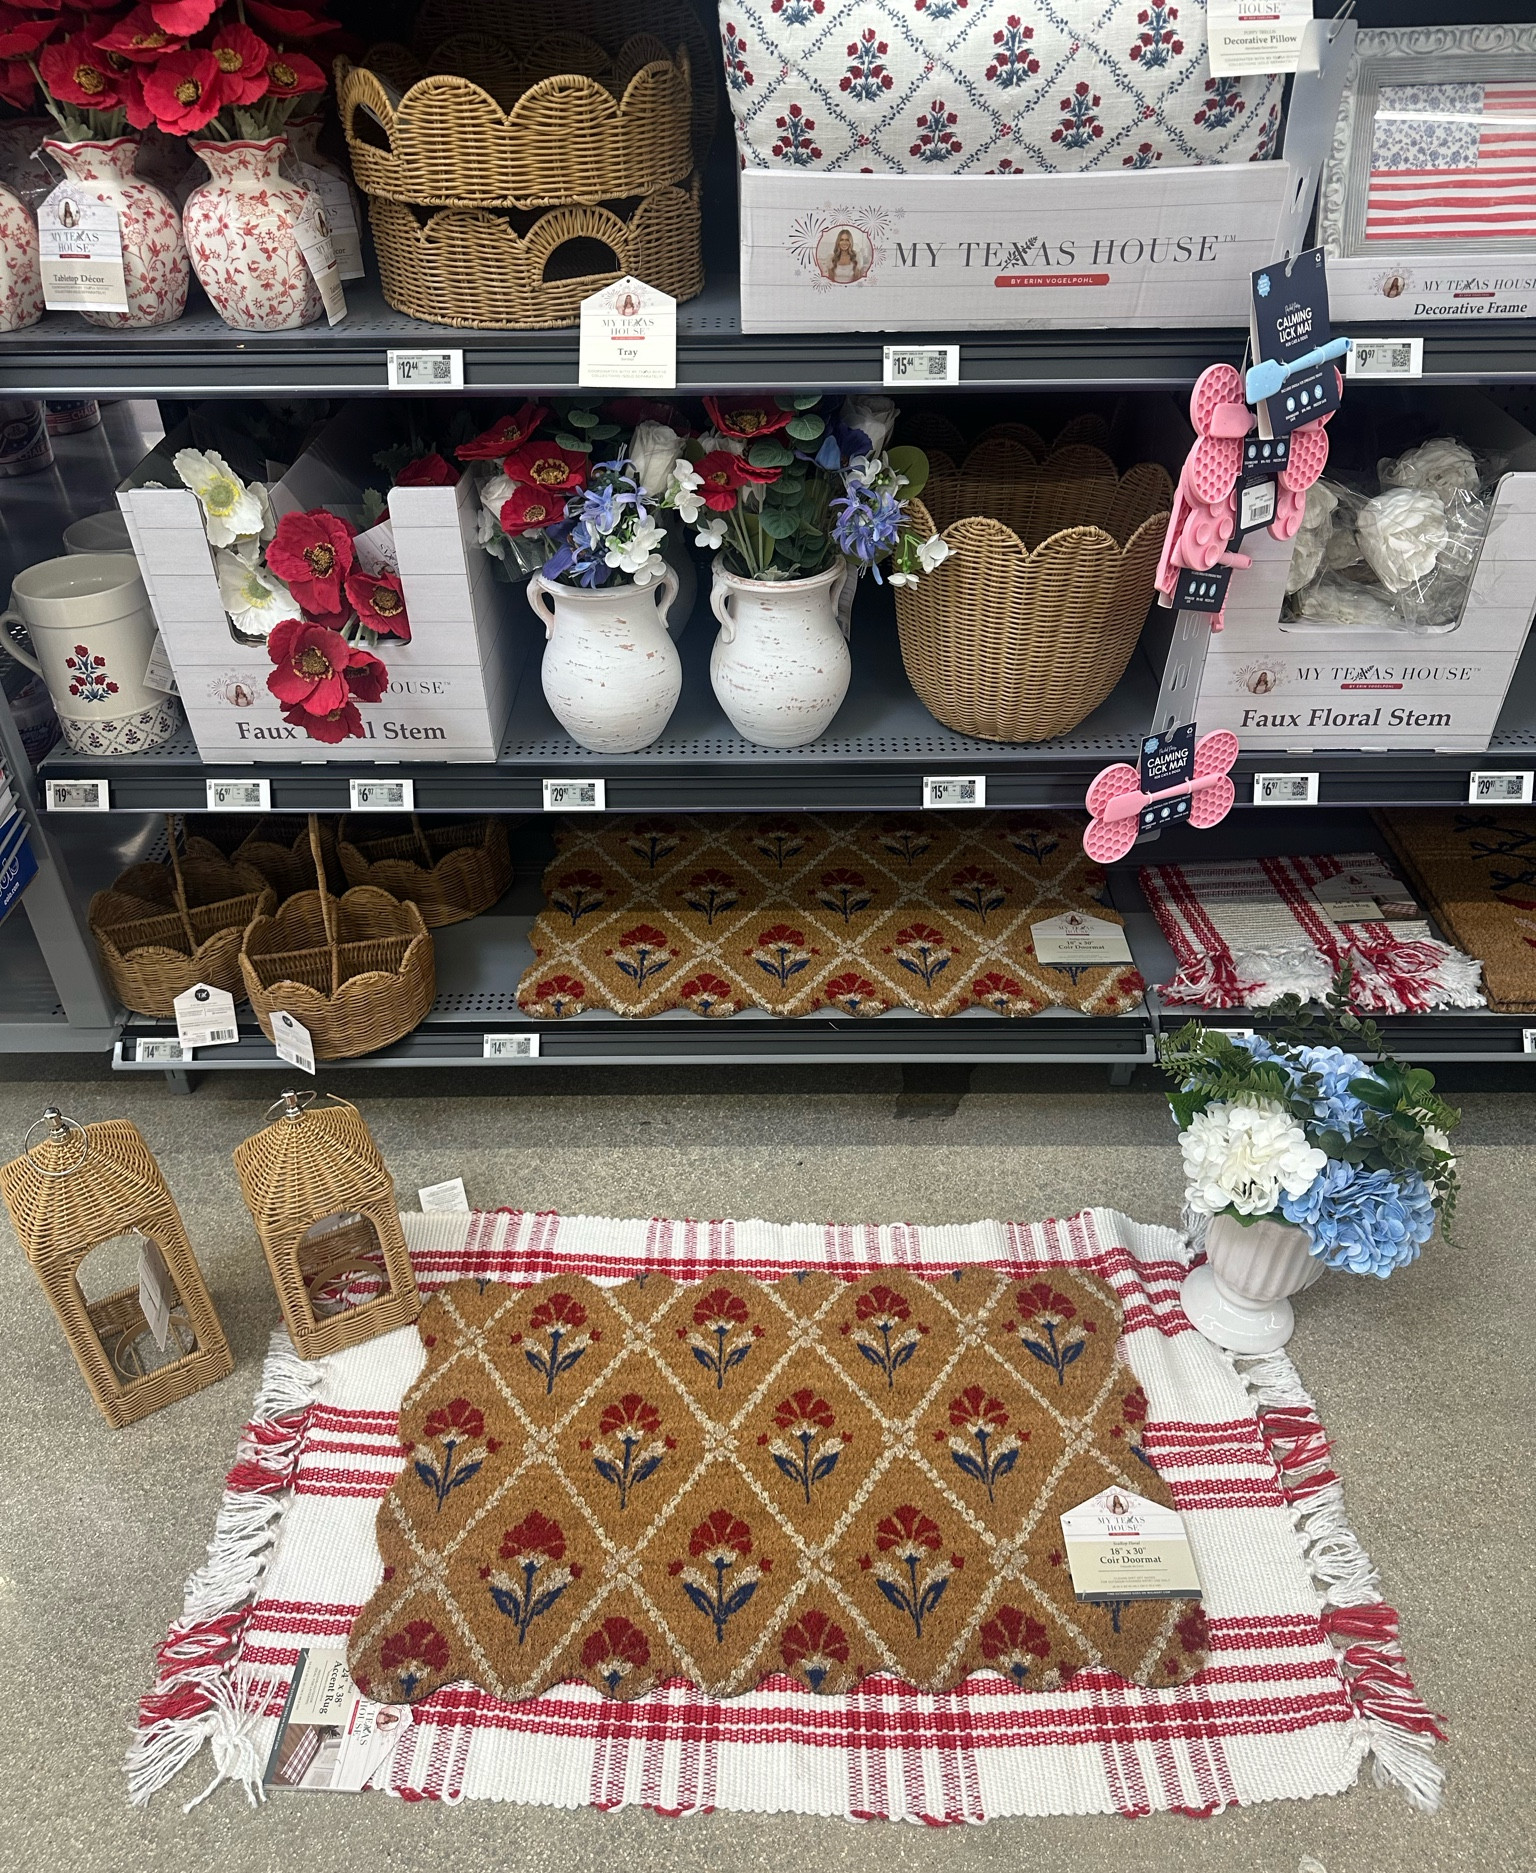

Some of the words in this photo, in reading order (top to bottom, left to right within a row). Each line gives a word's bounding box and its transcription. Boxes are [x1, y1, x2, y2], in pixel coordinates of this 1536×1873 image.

[1223, 35, 1268, 45] Decorative
[1270, 34, 1297, 43] Pillow
[51, 232, 62, 241] MY
[63, 231, 99, 242] TEXAS
[892, 242, 945, 267] MY
[958, 236, 1076, 271] TEXAS
[53, 275, 78, 284] Tabletop
[80, 275, 104, 283] Décor
[1422, 280, 1446, 291] MY
[1447, 278, 1490, 292] TEXAS
[1414, 302, 1484, 316] Decorative
[1486, 302, 1527, 314] Frame
[602, 319, 617, 327] MY
[620, 318, 655, 327] TEXAS
[1276, 307, 1312, 330] CALMING
[1280, 326, 1296, 343] LICK
[1297, 320, 1312, 336] MAT
[617, 348, 638, 357] Tray
[1295, 668, 1325, 680] MY
[1331, 665, 1395, 682] TEXAS
[1240, 709, 1302, 728] Faux
[1307, 708, 1382, 727] Floral
[1387, 708, 1452, 727] Stem
[235, 721, 296, 740] Faux
[383, 721, 447, 740] Stem
[1147, 748, 1188, 768] CALMING
[1149, 763, 1167, 777] LICK
[1169, 757, 1187, 770] MAT
[1115, 1516, 1145, 1524] TEXAS
[1100, 1556, 1119, 1564] Coir
[327, 1660, 343, 1692] Accent
[318, 1694, 334, 1715] Rug
[360, 1710, 375, 1745] TEXAS
